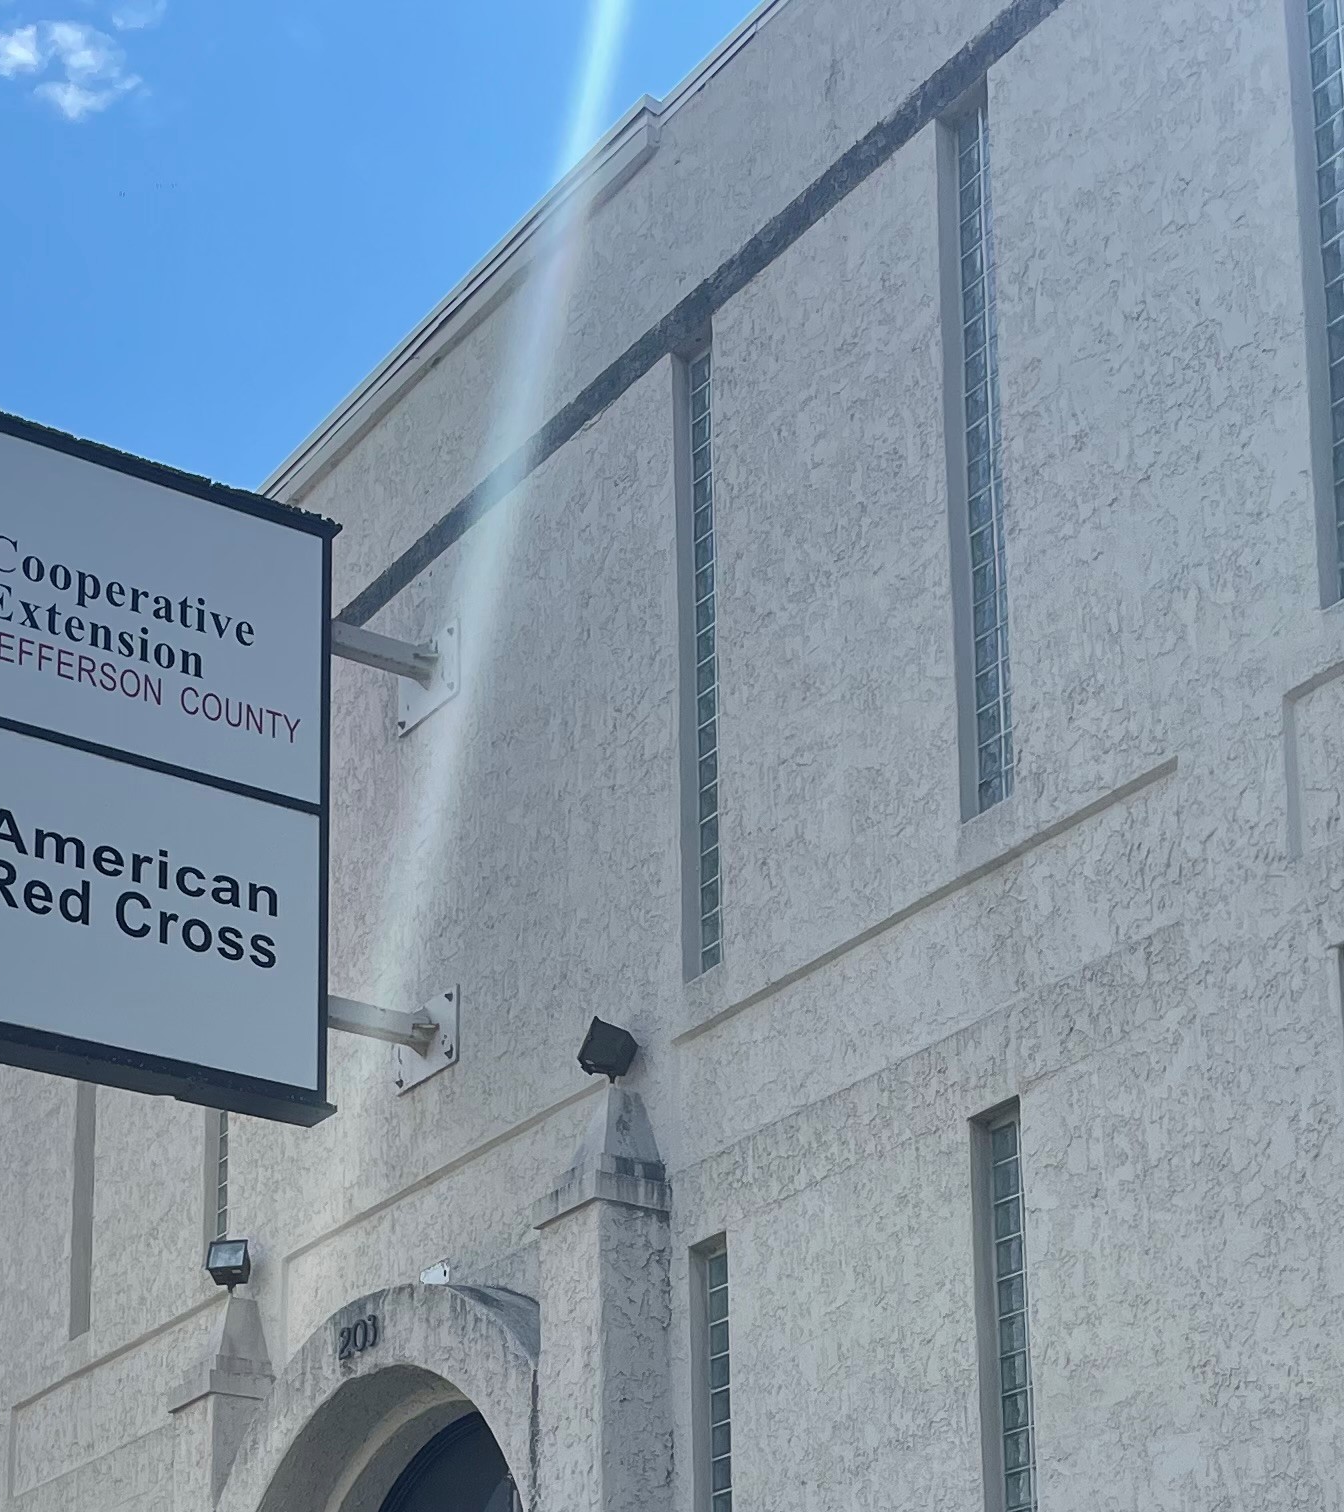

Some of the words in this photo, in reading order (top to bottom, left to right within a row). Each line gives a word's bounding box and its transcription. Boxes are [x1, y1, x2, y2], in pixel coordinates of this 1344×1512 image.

[180, 686, 302, 744] COUNTY
[115, 890, 277, 969] Cross
[338, 1314, 377, 1361] 203
